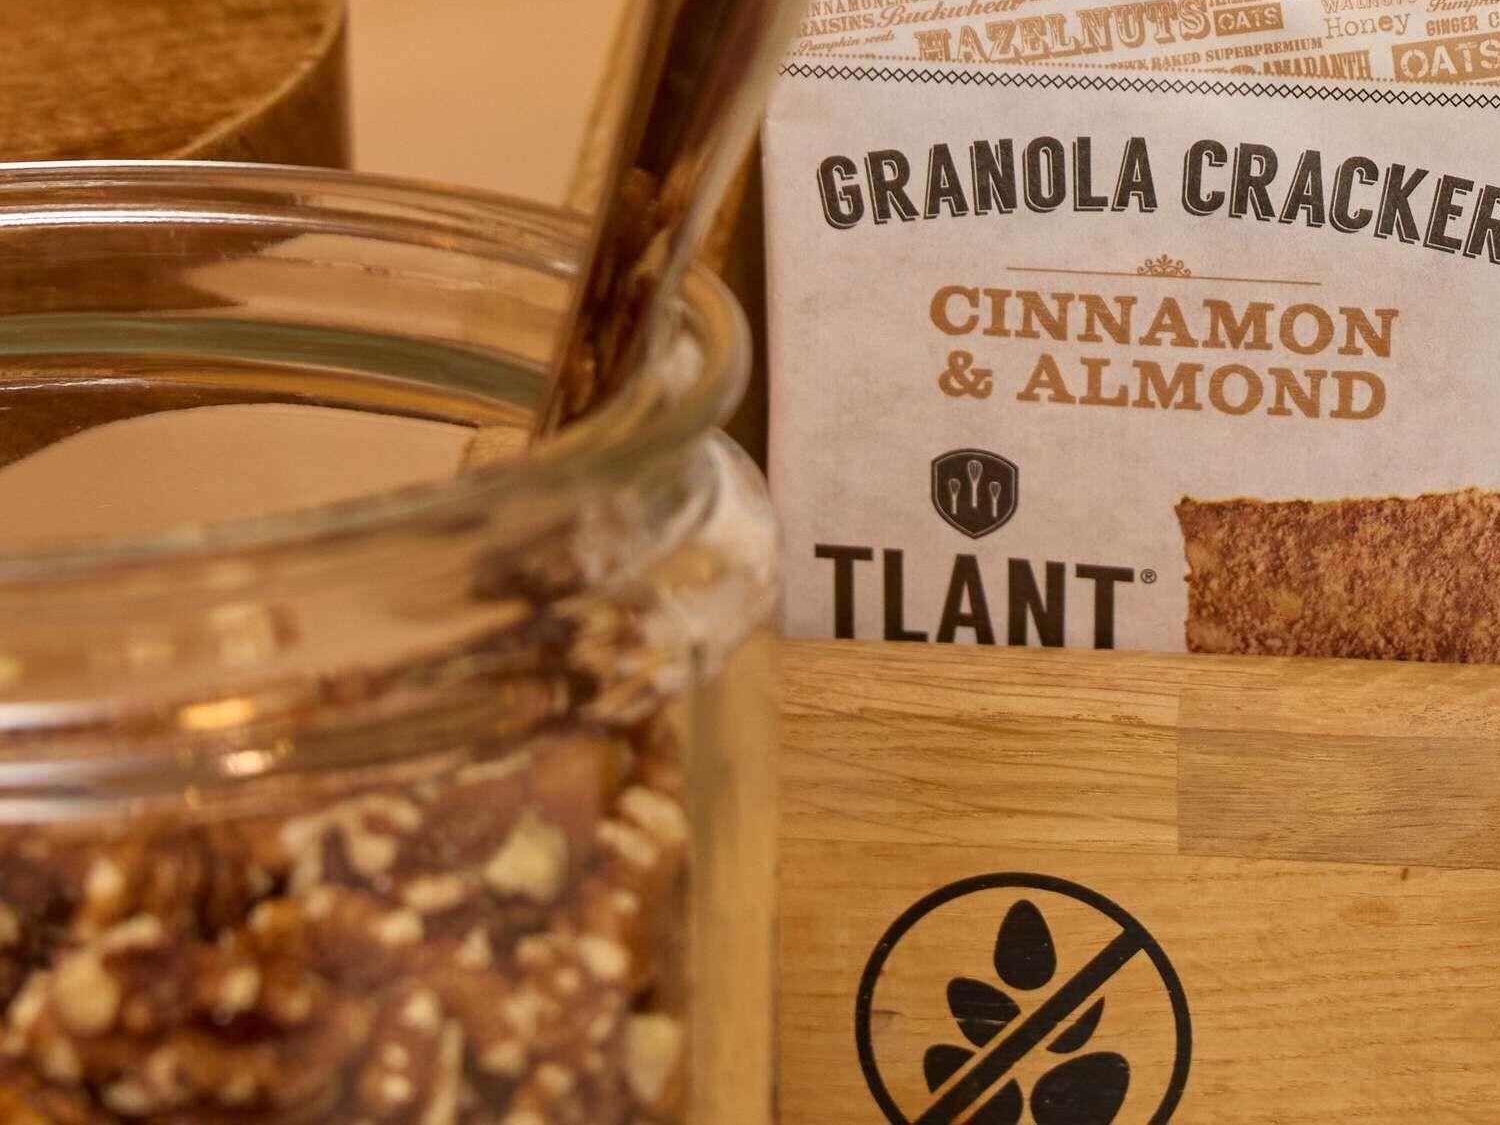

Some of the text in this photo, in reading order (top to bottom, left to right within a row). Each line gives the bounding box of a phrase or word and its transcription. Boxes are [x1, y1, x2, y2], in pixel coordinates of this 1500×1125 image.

[1216, 6, 1280, 33] OATS
[1323, 11, 1411, 40] Honey
[1426, 15, 1479, 37] GINGER
[800, 29, 896, 53] Pumpkin seeds
[1205, 37, 1323, 63] SUPERPREMIUM
[816, 136, 1158, 232] GRANOLA
[929, 284, 1400, 360] CINNAMON
[938, 348, 1388, 421] & ALMOND
